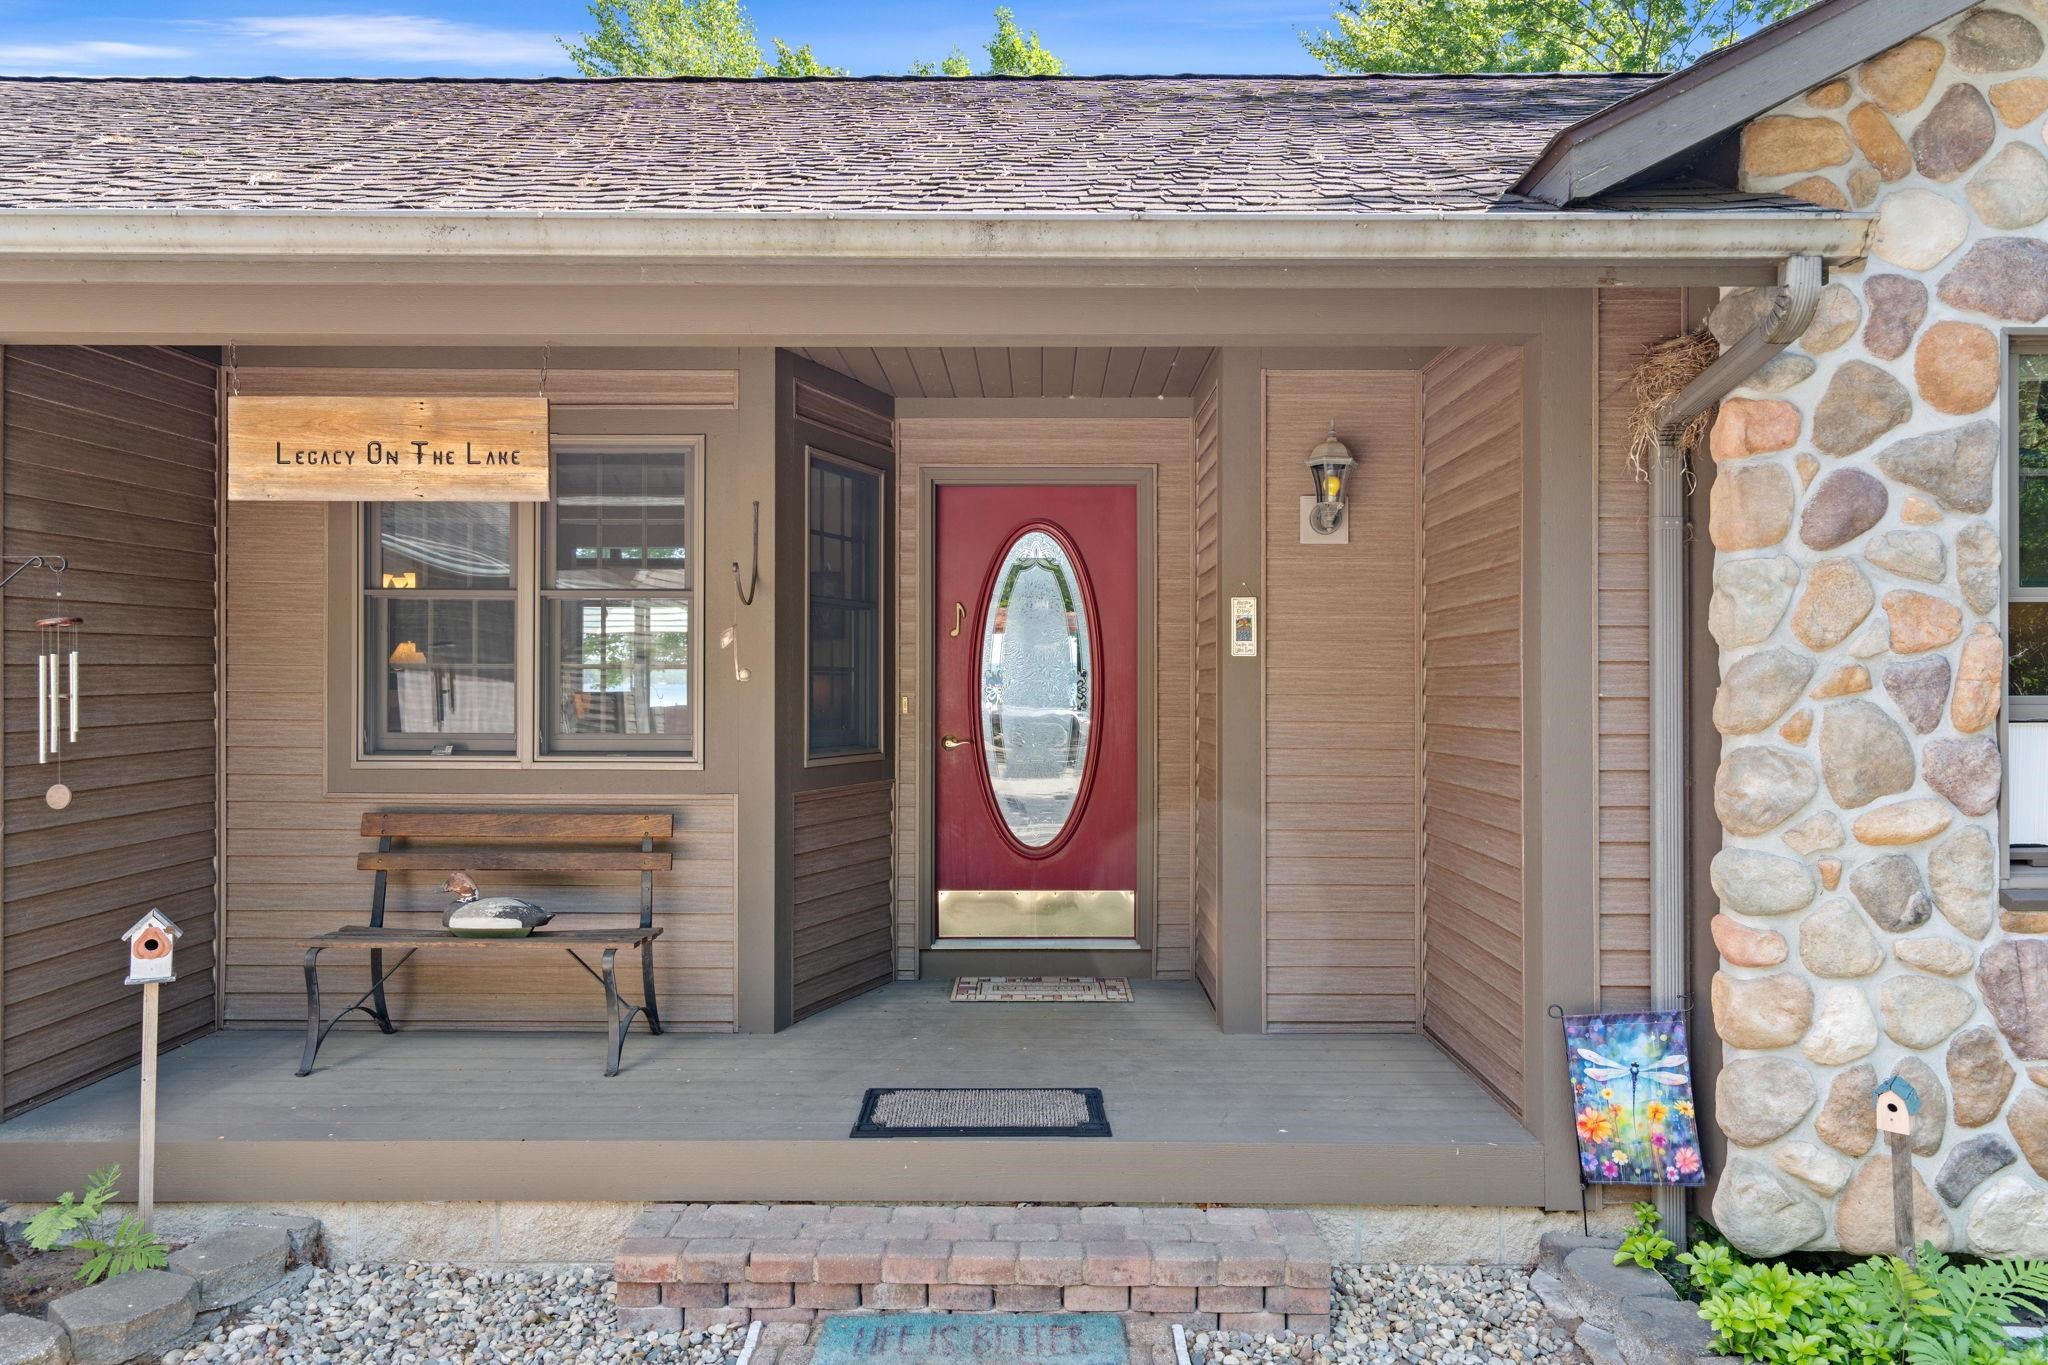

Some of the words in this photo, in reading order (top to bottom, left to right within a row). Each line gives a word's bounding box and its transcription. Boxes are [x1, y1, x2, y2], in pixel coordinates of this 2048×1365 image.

[276, 441, 356, 465] LEGACY
[367, 440, 399, 465] ON
[410, 440, 455, 465] THE
[466, 441, 521, 465] LAKE
